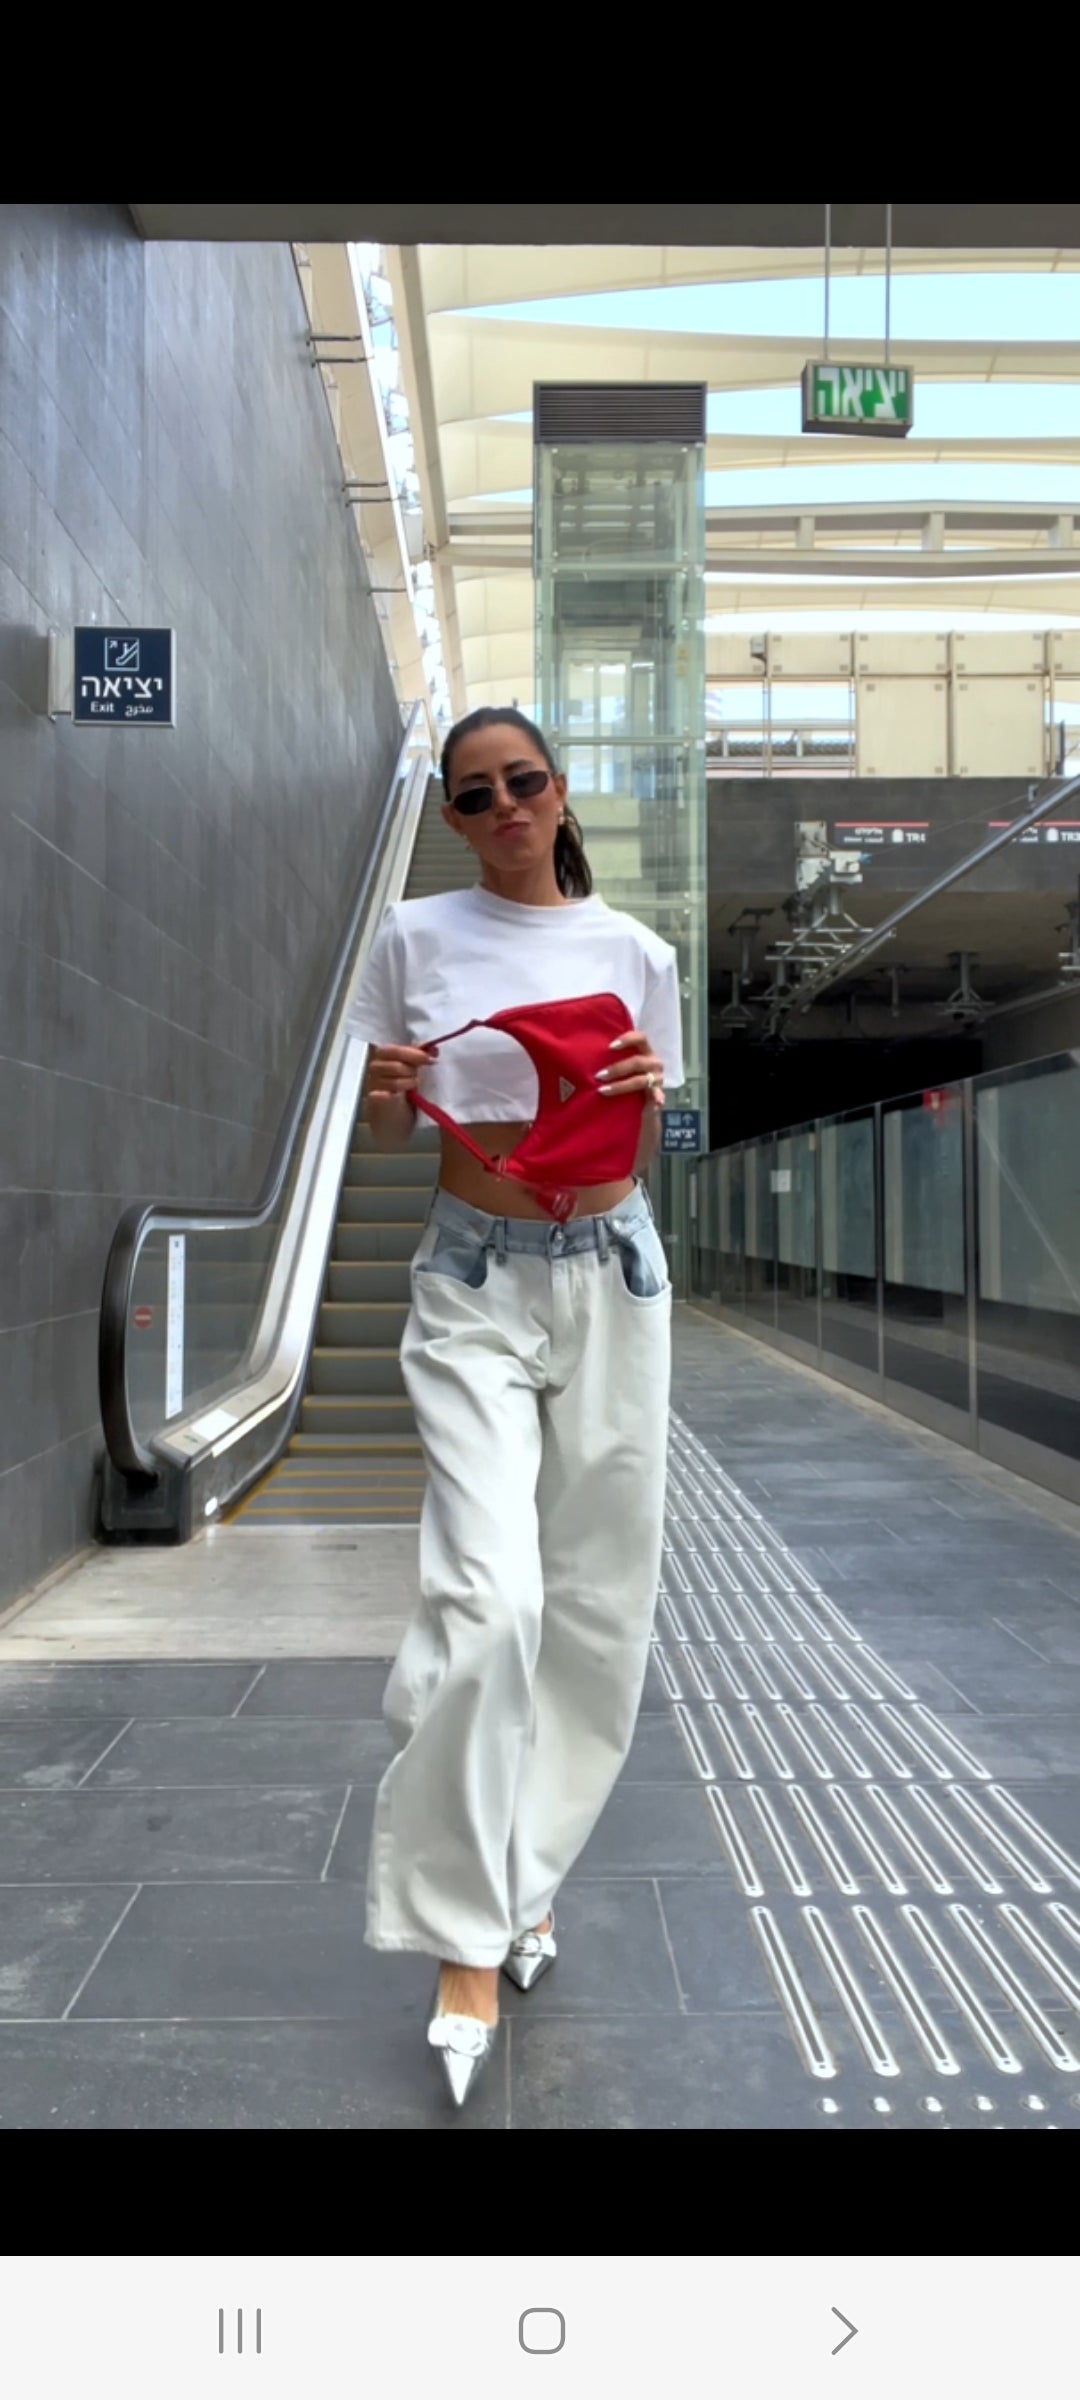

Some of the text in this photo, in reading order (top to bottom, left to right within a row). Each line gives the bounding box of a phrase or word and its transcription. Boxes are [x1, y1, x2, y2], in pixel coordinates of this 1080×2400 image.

[818, 367, 905, 418] יציאה
[81, 676, 162, 698] יציאה
[90, 701, 114, 713] Exit
